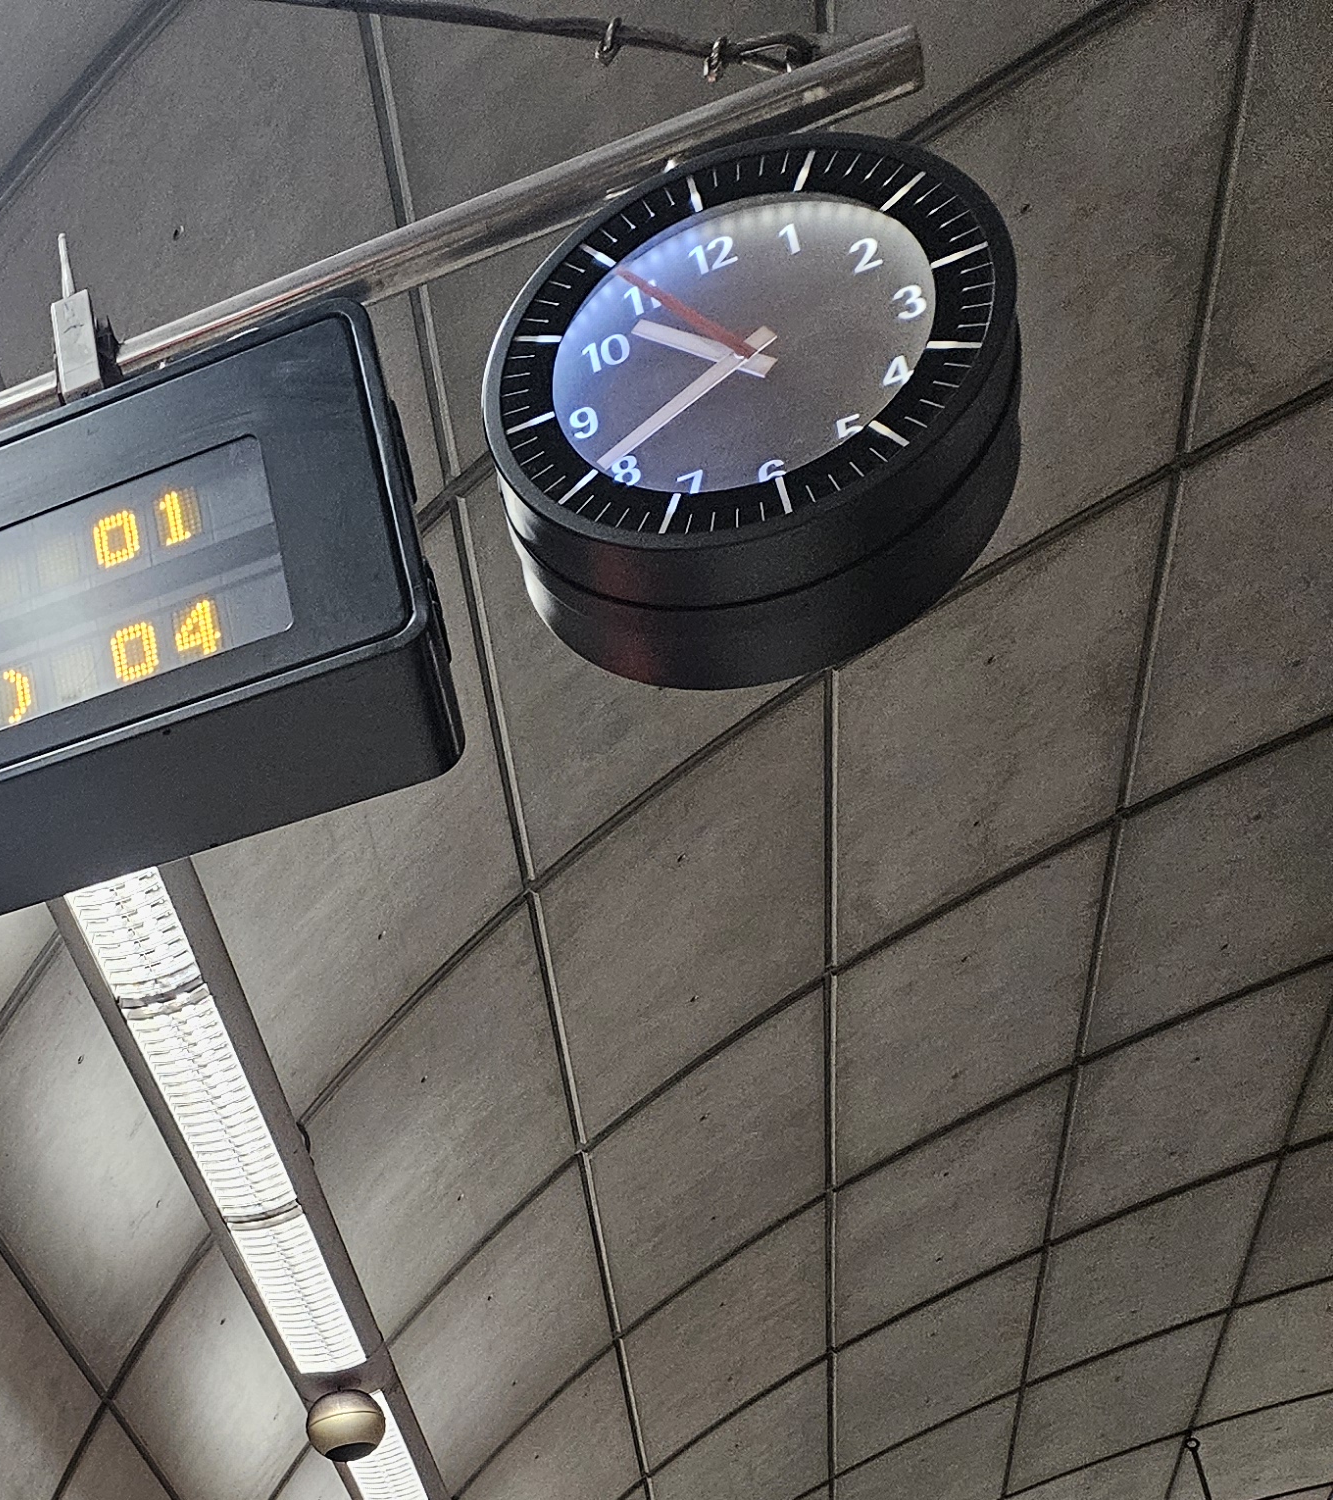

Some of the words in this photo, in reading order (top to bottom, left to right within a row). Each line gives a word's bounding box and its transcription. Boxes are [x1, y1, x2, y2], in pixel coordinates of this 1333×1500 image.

[688, 236, 738, 275] 12
[778, 223, 800, 255] 1
[847, 237, 883, 275] 2
[891, 285, 927, 319] 3
[582, 334, 630, 373] 10
[883, 355, 915, 386] 4
[569, 406, 599, 439] 9
[836, 413, 863, 439] 5
[611, 455, 641, 486] 8
[677, 469, 703, 494] 7
[93, 490, 192, 569] 01
[110, 599, 222, 683] 04
